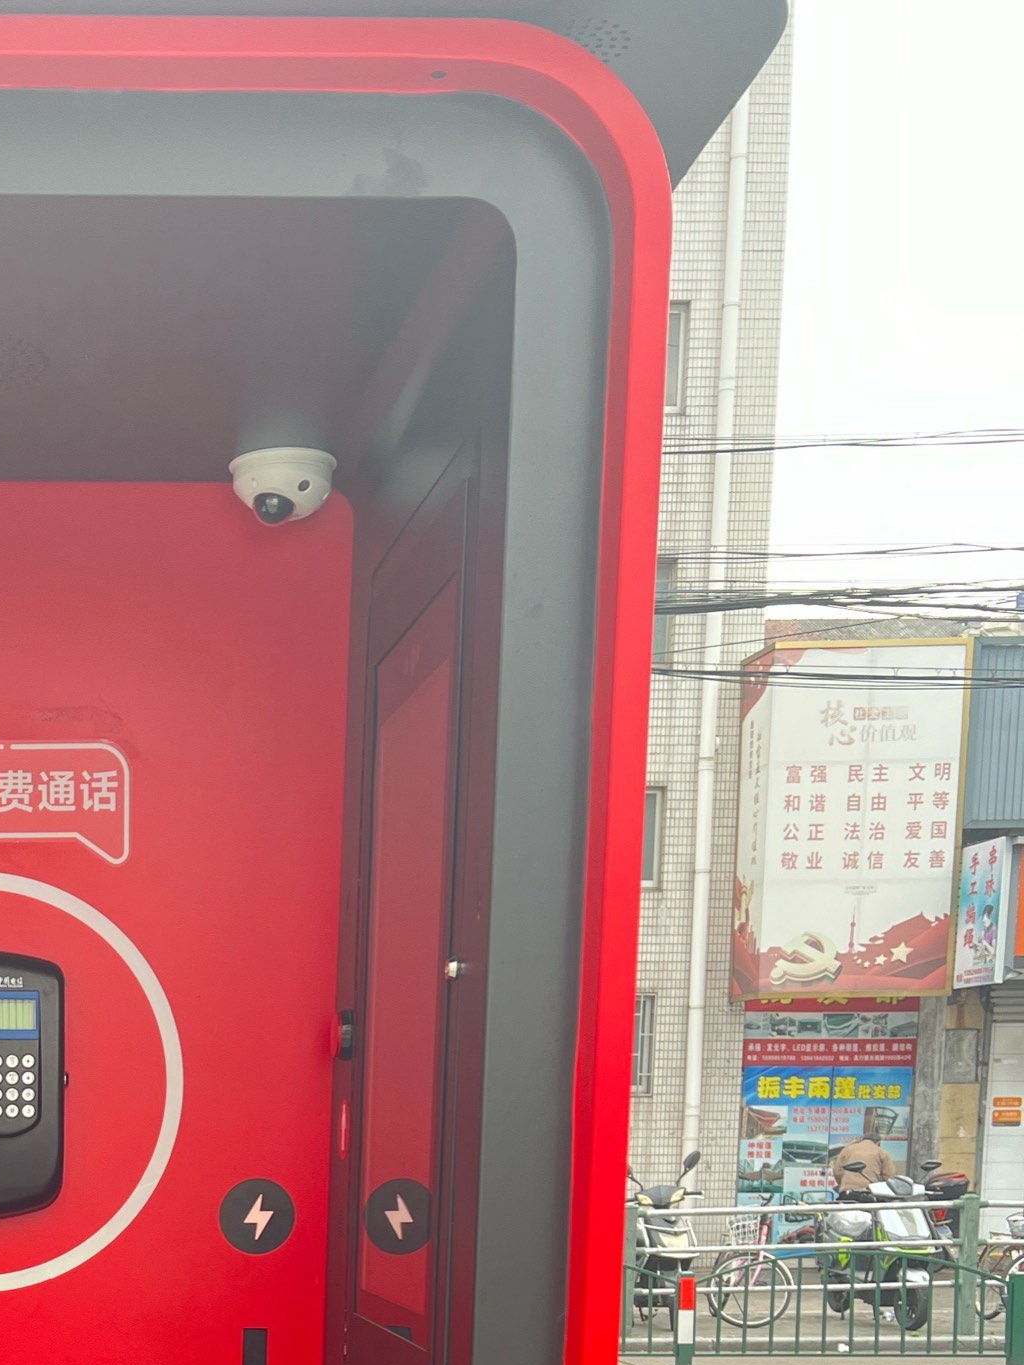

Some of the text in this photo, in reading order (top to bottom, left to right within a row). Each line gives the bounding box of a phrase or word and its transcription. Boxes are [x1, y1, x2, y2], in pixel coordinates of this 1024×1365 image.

[860, 724, 917, 742] 价值观
[785, 762, 952, 784] 富强 民主 文明
[784, 791, 950, 813] 和谐 自由 平等
[783, 821, 947, 841] 公正 法治 爱国
[781, 850, 946, 870] 敬业 诚信 友善
